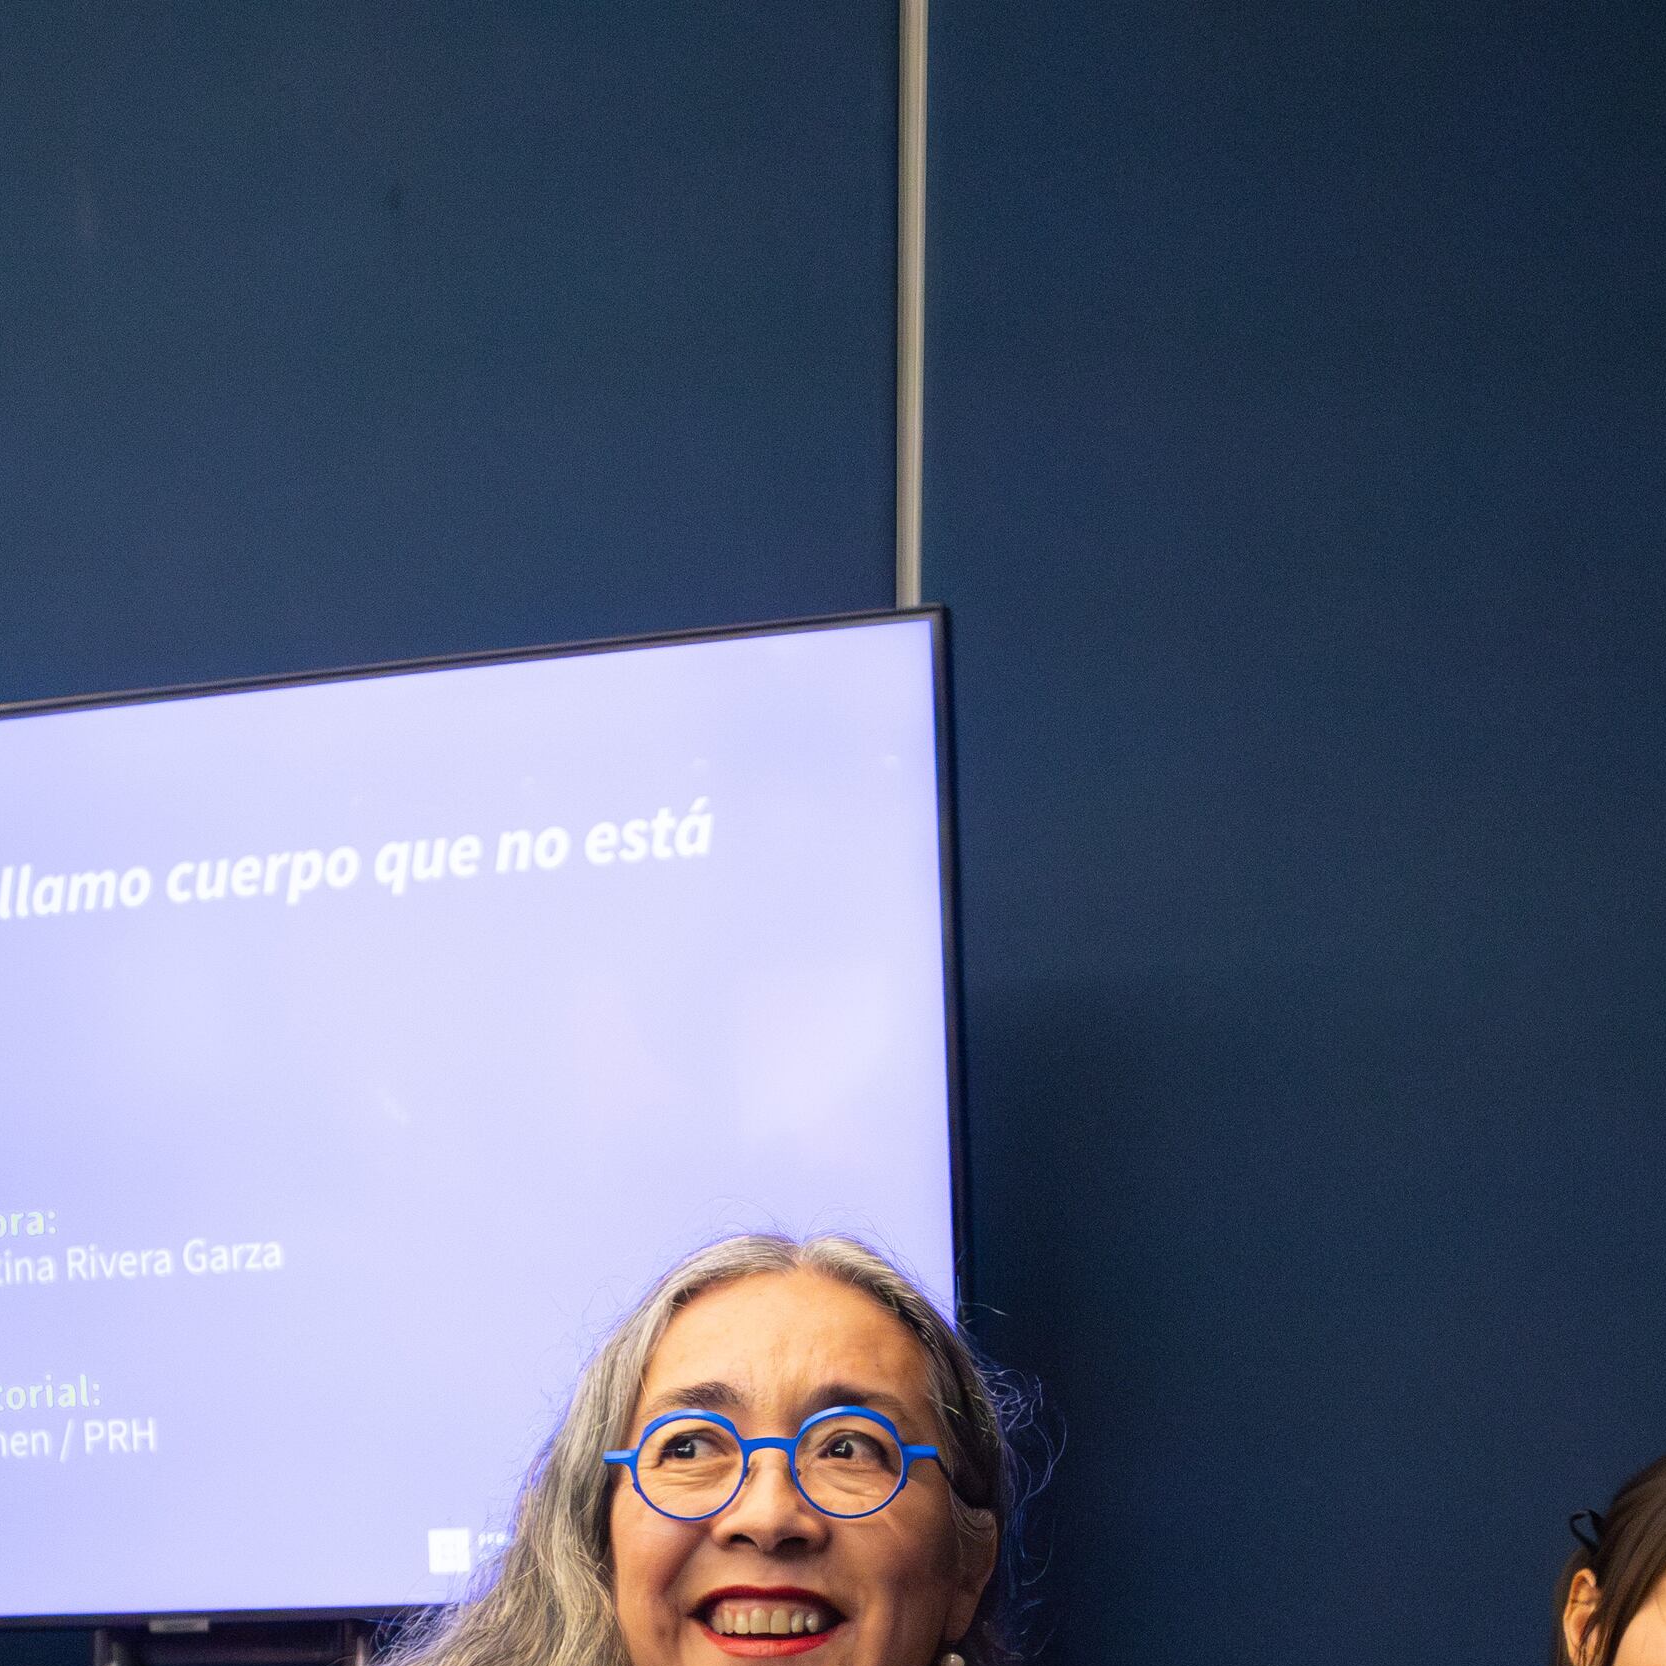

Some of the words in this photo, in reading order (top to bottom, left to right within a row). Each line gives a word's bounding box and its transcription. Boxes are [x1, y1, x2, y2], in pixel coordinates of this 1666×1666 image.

[166, 846, 360, 907] cuerpo
[374, 834, 484, 896] que
[494, 826, 571, 874] no
[584, 796, 715, 865] está
[65, 1244, 174, 1282] Rivera
[182, 1238, 284, 1275] Garza
[59, 1418, 74, 1463] /
[83, 1416, 157, 1454] PRH
